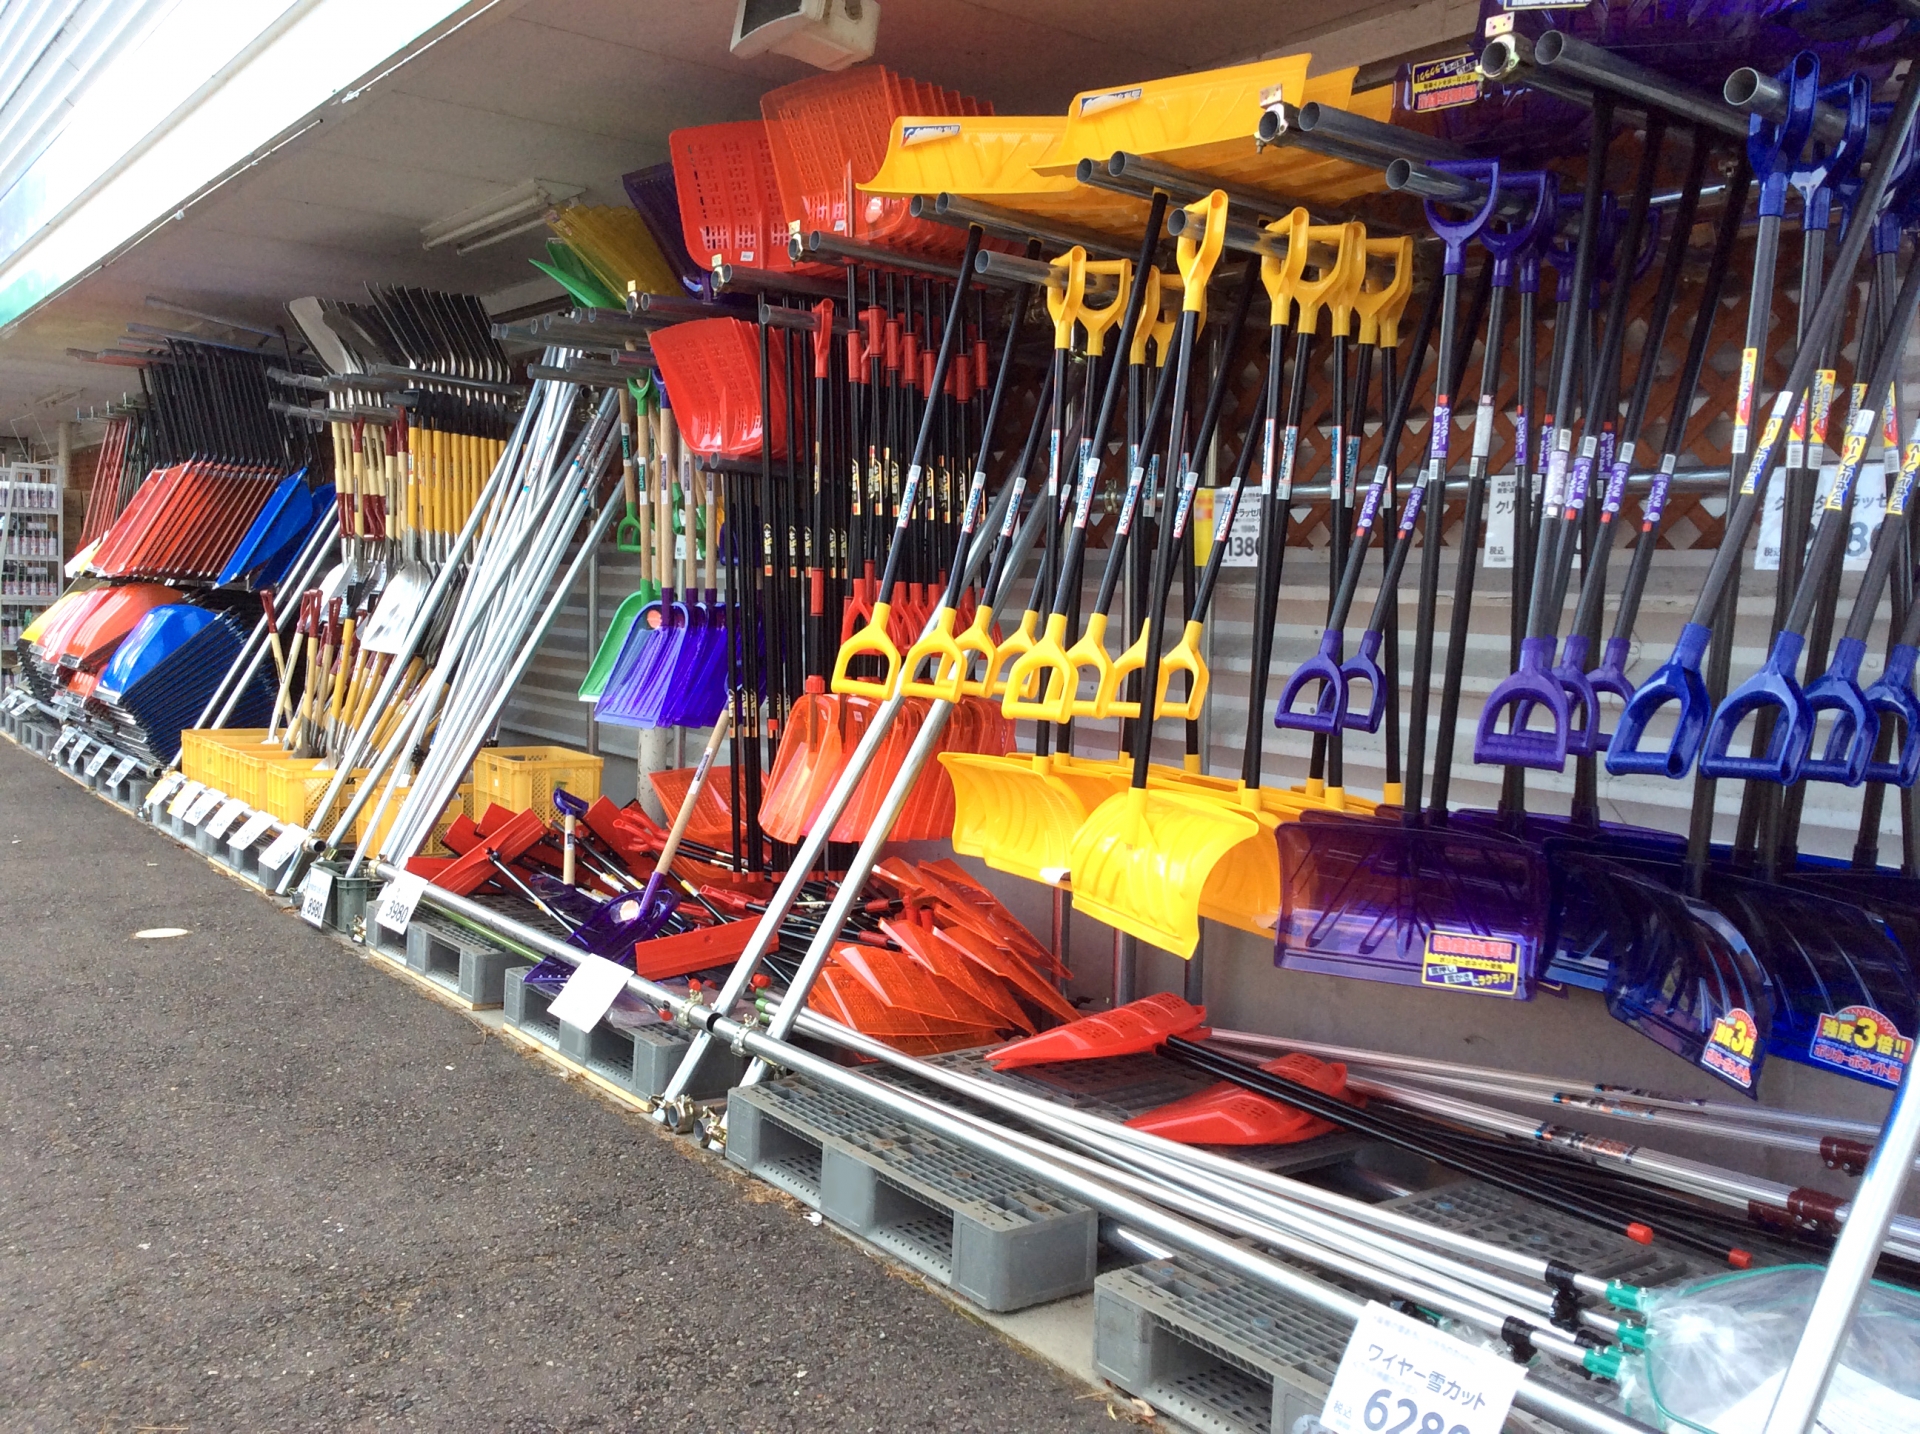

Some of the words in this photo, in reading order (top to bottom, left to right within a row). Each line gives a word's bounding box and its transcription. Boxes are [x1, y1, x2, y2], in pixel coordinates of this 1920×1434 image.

[1431, 422, 1441, 451] ラッセル
[1441, 407, 1450, 446] クリスター
[385, 900, 409, 924] 3980
[1368, 1343, 1486, 1411] ワイヤー雪カット
[1333, 1400, 1352, 1419] 税込
[1363, 1388, 1471, 1434] 628
